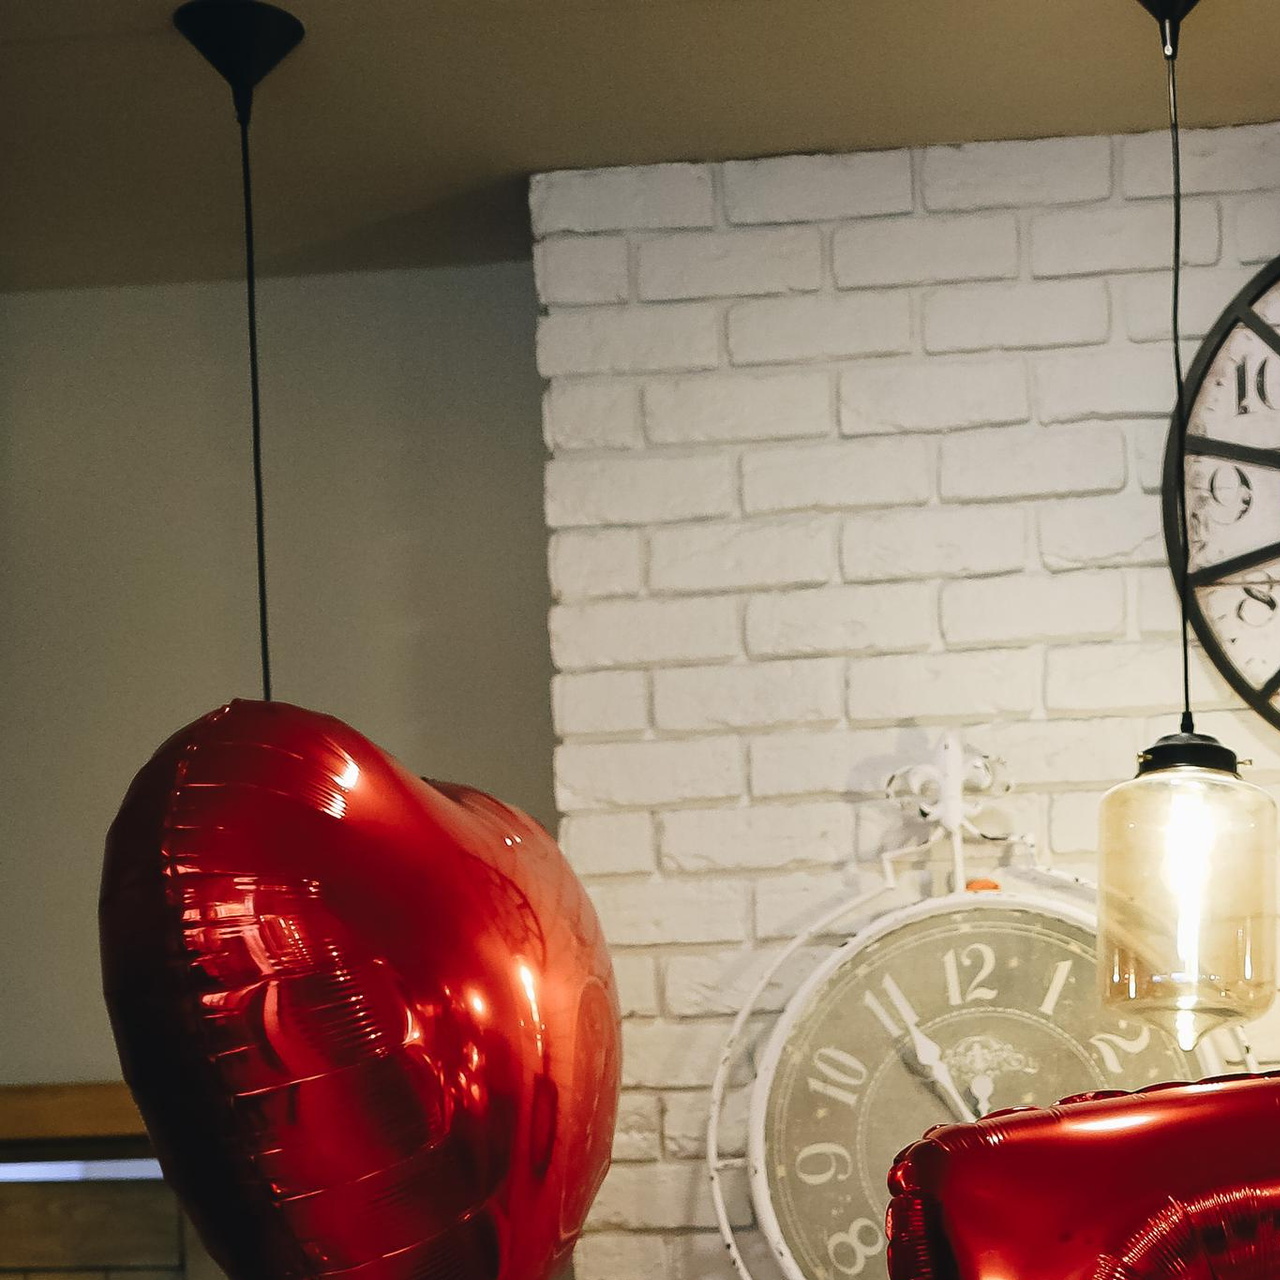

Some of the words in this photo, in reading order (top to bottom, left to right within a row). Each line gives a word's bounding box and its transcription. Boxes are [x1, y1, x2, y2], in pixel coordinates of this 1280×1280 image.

[1208, 464, 1253, 526] 9
[1235, 569, 1277, 627] 8
[941, 941, 998, 1006] 12
[1038, 958, 1074, 1016] 1
[864, 973, 920, 1039] 11
[807, 1046, 870, 1105] 10
[1089, 1022, 1152, 1074] 2
[795, 1141, 853, 1186] 9
[826, 1217, 886, 1277] 8
